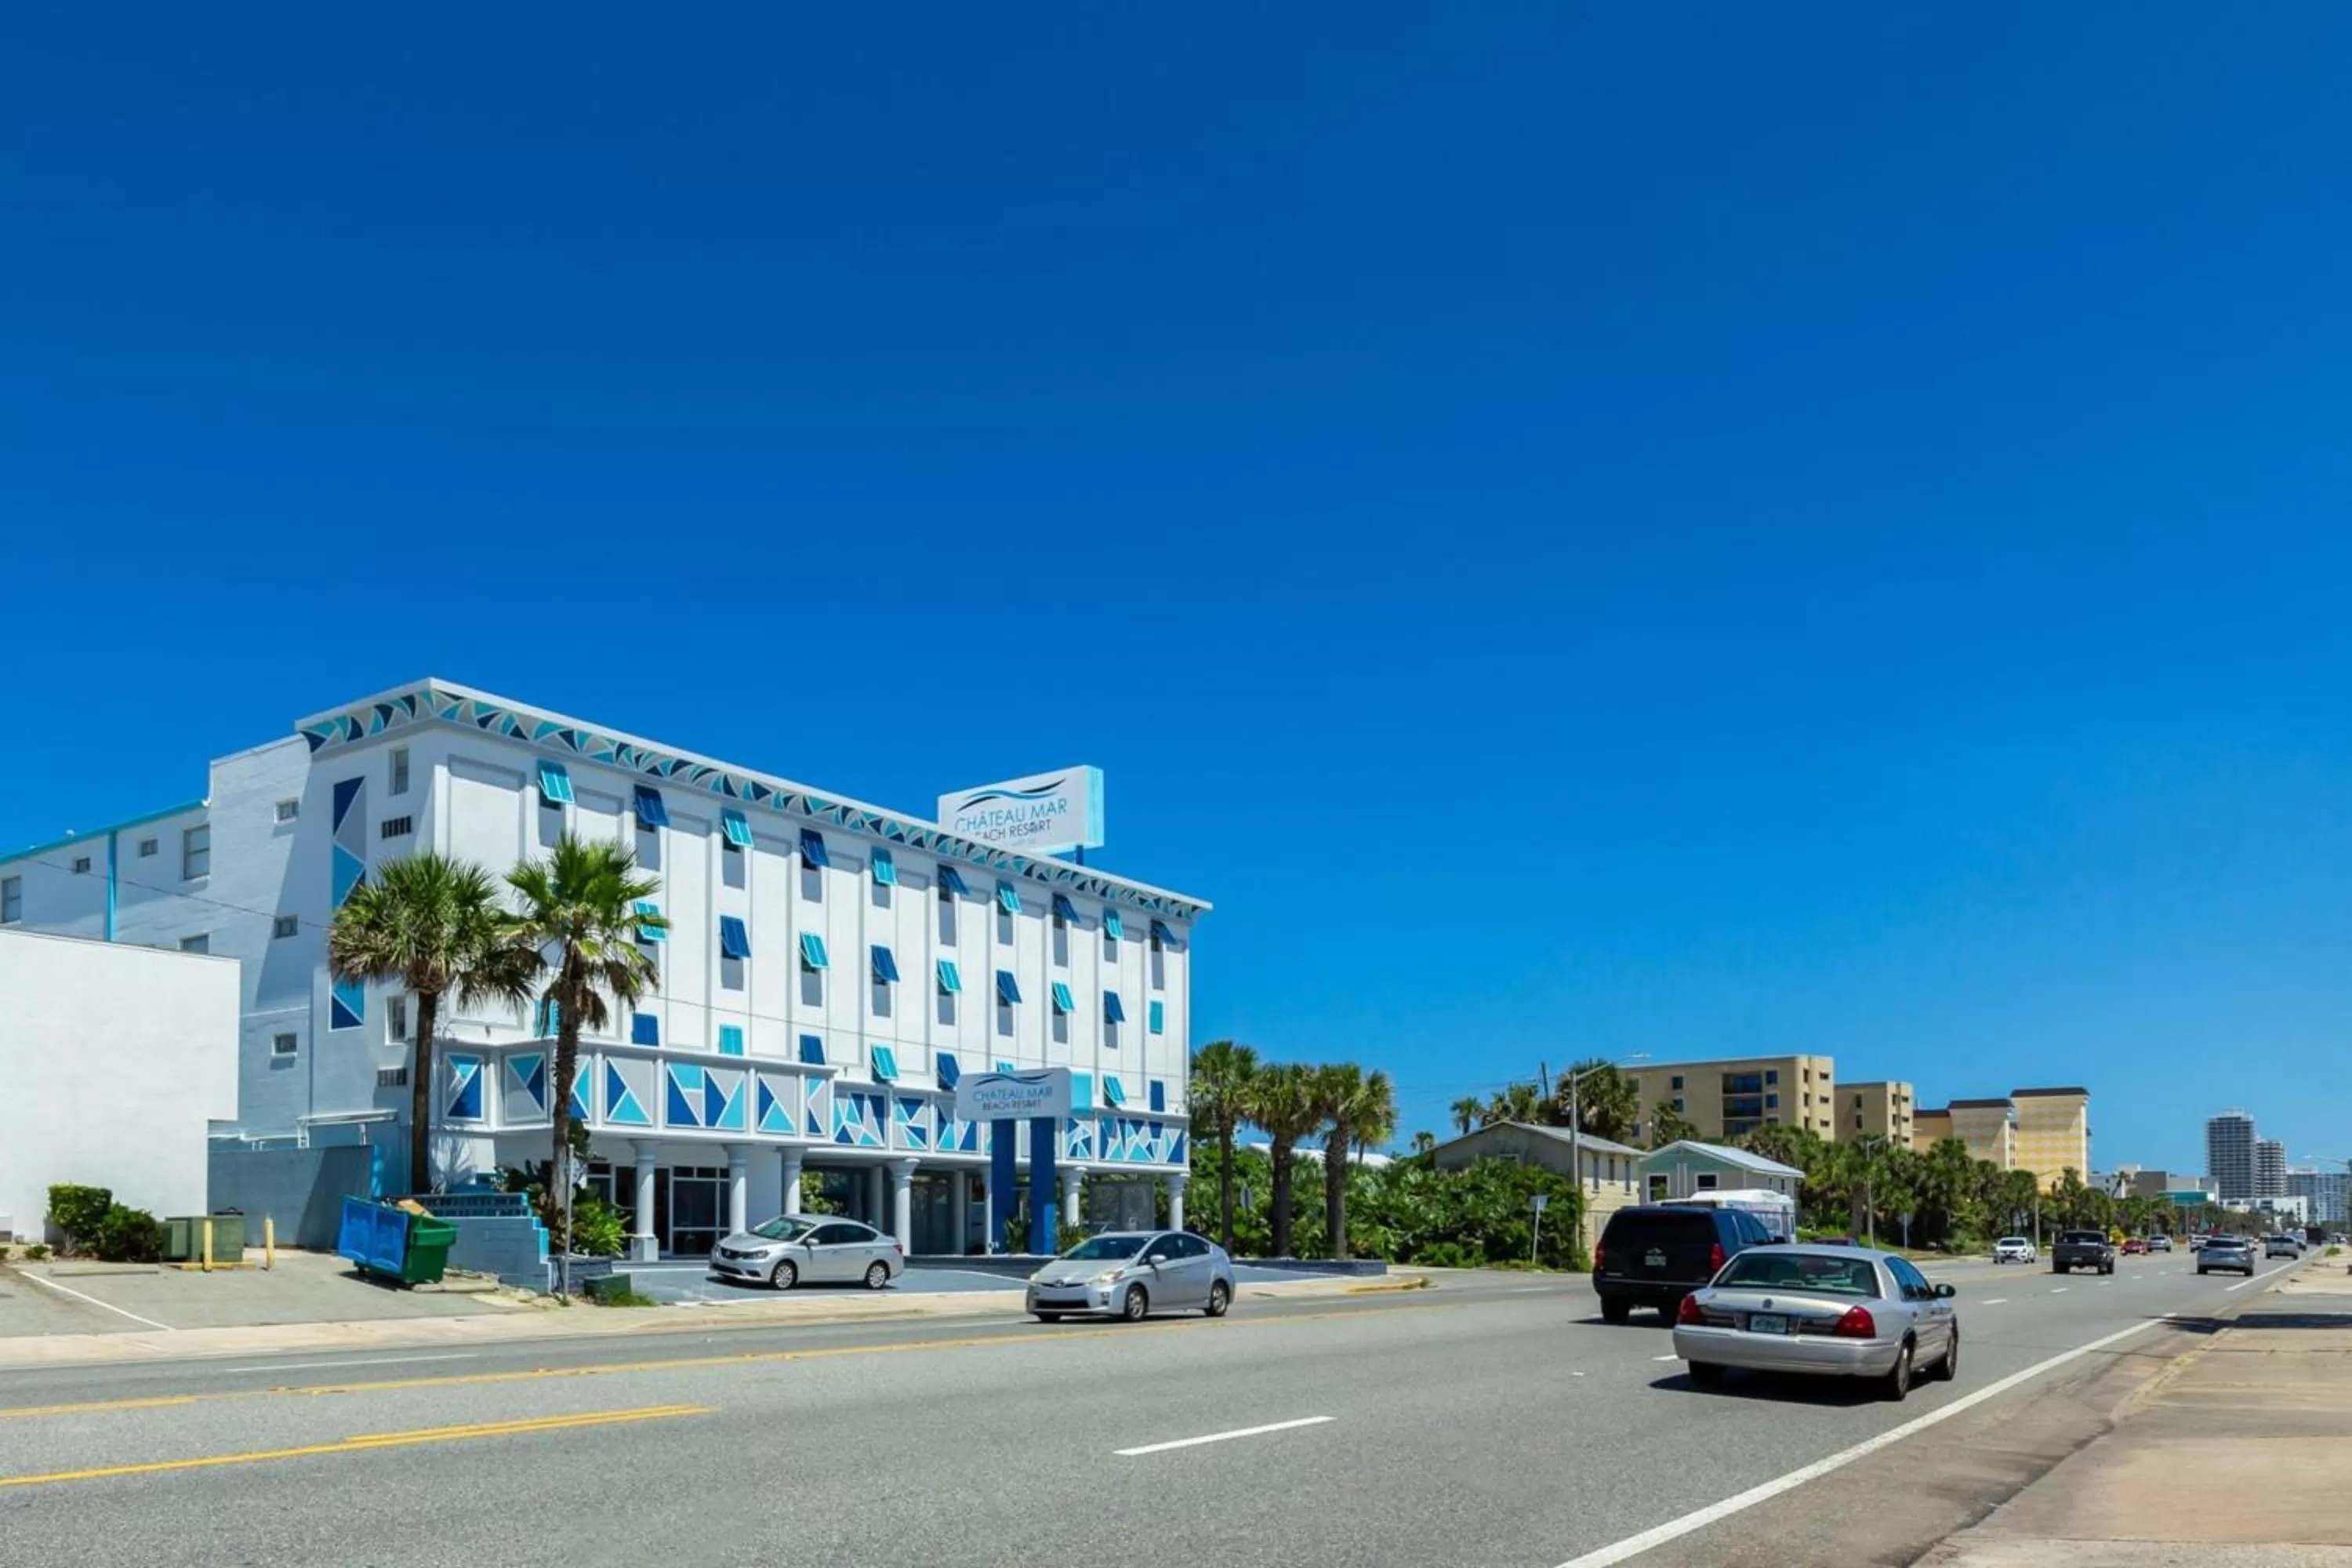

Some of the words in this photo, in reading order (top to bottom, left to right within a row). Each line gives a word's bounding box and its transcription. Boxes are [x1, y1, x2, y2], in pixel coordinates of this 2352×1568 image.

[1029, 798, 1067, 818] MAR
[1009, 818, 1051, 837] RESORT
[1027, 1086, 1053, 1098] MAR
[982, 1100, 1010, 1110] BEACH
